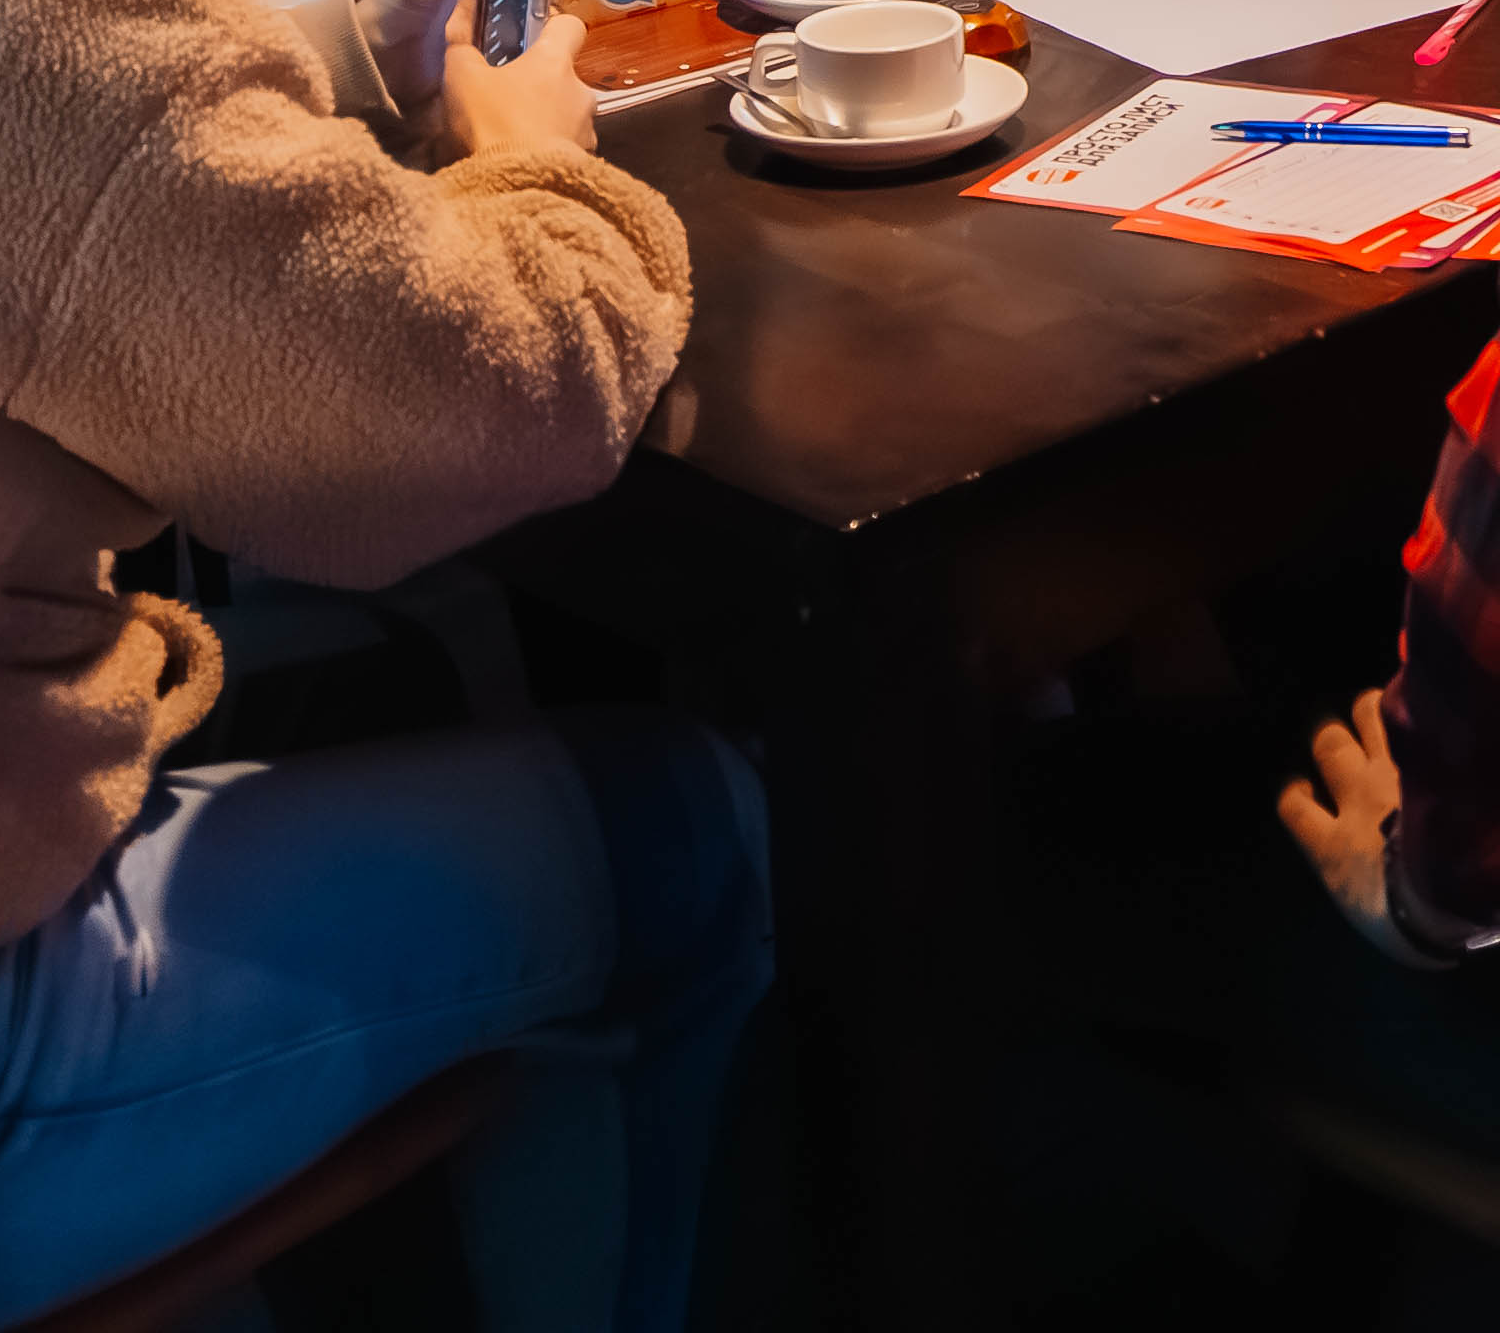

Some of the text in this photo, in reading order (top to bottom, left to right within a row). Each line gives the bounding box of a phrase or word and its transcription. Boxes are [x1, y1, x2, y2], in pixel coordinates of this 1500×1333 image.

[1052, 94, 1171, 164] ПРОСТО ЛИСТ
[1078, 103, 1185, 167] ДЛЯ ЗАПИСИ
